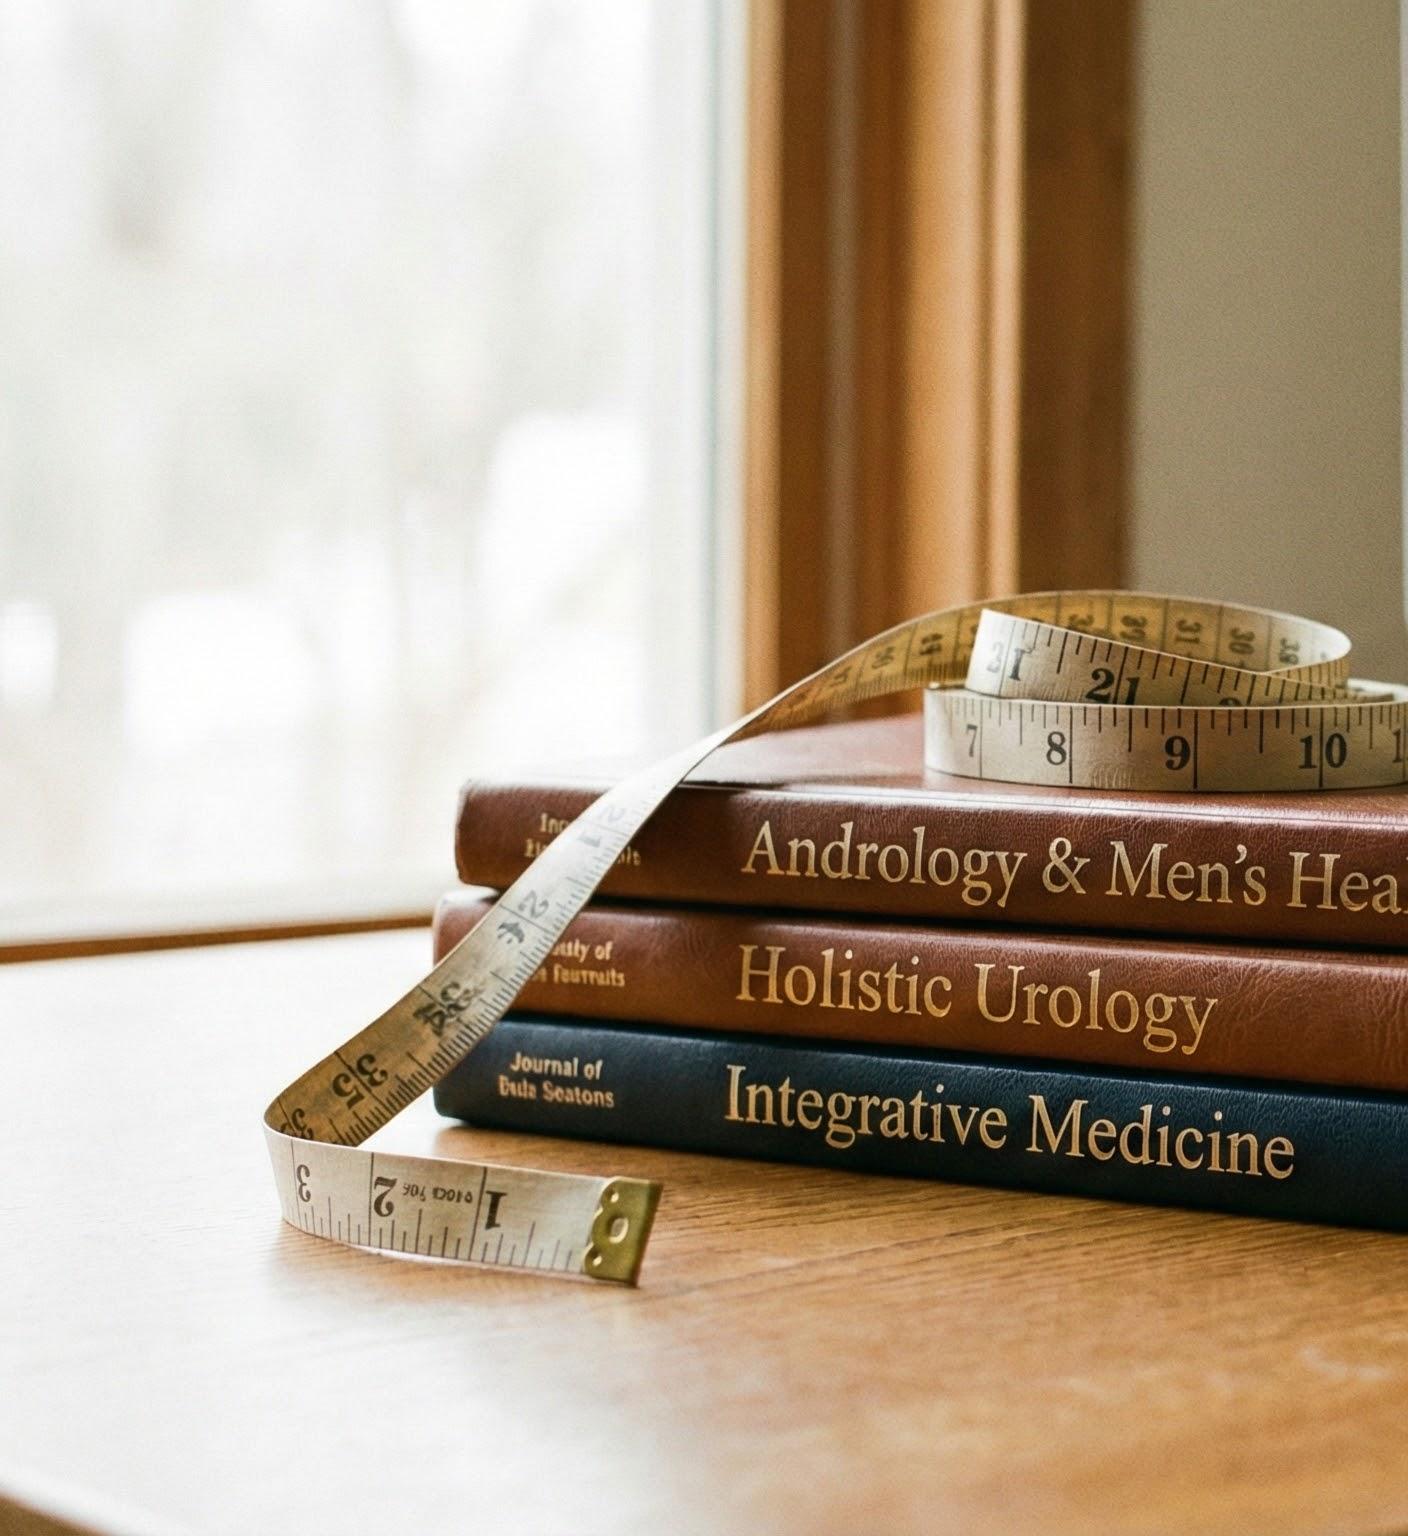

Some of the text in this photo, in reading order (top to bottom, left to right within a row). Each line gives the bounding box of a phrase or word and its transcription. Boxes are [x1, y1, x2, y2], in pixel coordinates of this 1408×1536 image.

[966, 723, 978, 758] 7
[1046, 731, 1067, 766] 8
[1164, 735, 1191, 771] 9
[1298, 732, 1348, 769] 10
[740, 820, 1028, 908] Andrology
[1042, 837, 1091, 895] &
[1105, 840, 1268, 906] Men's
[594, 941, 614, 961] of
[736, 944, 1219, 1056] Holistic Urology
[332, 1053, 389, 1110] 35
[510, 1051, 604, 1080] Journal of
[724, 1064, 1295, 1180] Integrative Medicine
[295, 1164, 312, 1203] 3
[373, 1176, 398, 1218] 2
[484, 1189, 509, 1230] 1
